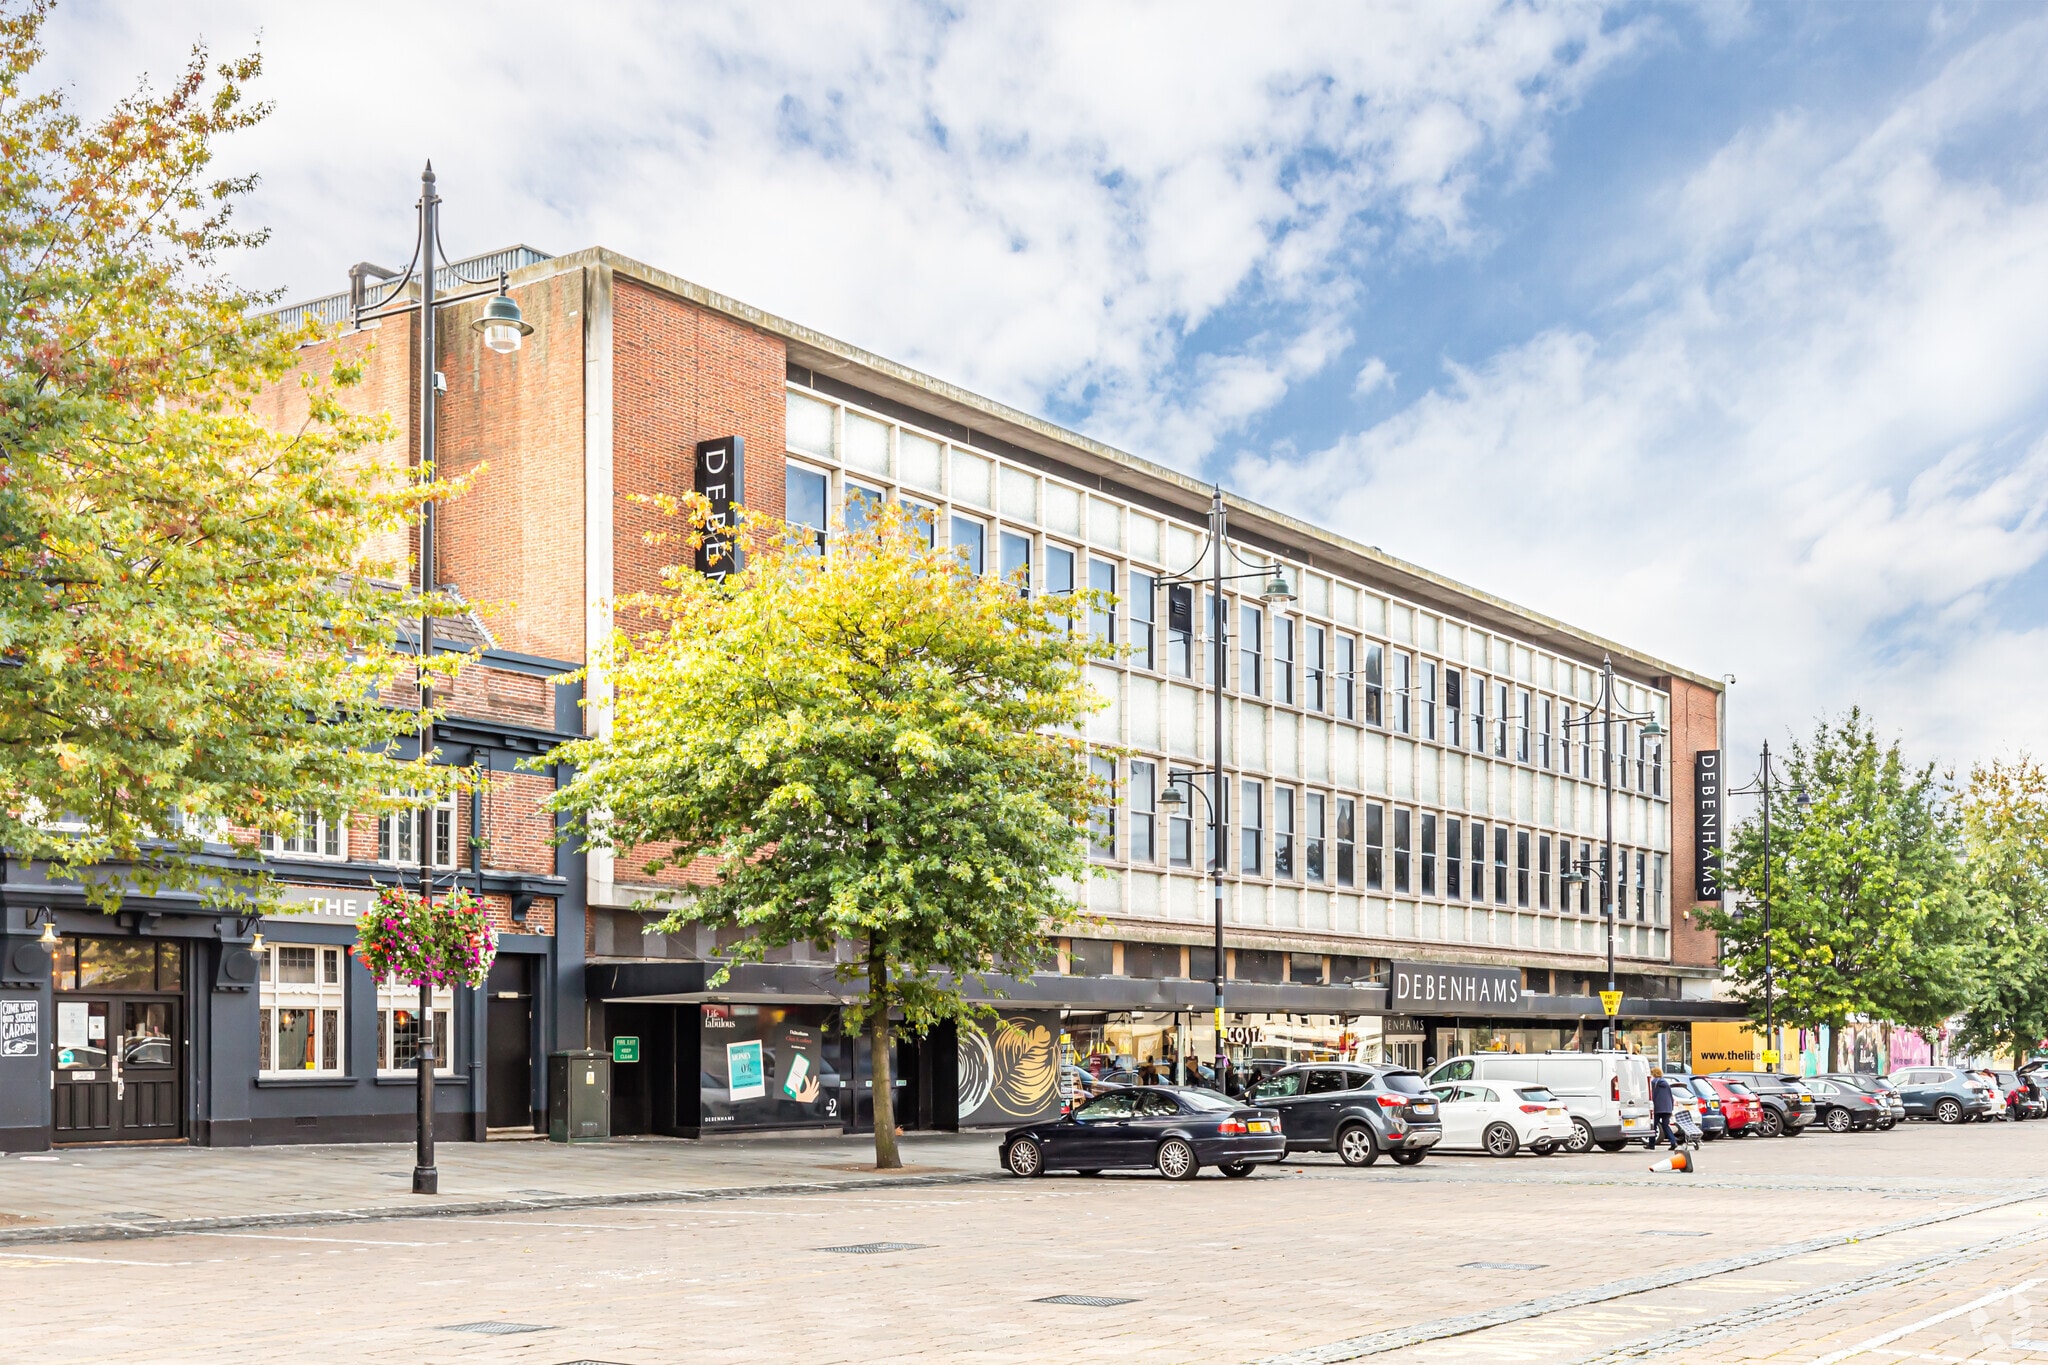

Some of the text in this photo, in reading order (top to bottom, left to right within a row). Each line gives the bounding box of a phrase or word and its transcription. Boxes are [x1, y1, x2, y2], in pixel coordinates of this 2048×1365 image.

[1702, 755, 1716, 896] DEBENHAMS
[309, 897, 357, 917] THE
[1397, 973, 1518, 1004] DEBENHAMS
[3, 1003, 36, 1014] COME VISIT
[3, 1011, 36, 1022] OUR SECRET
[3, 1022, 36, 1039] GARDEN
[705, 1018, 736, 1028] fabulous
[1228, 1027, 1264, 1044] COSTA
